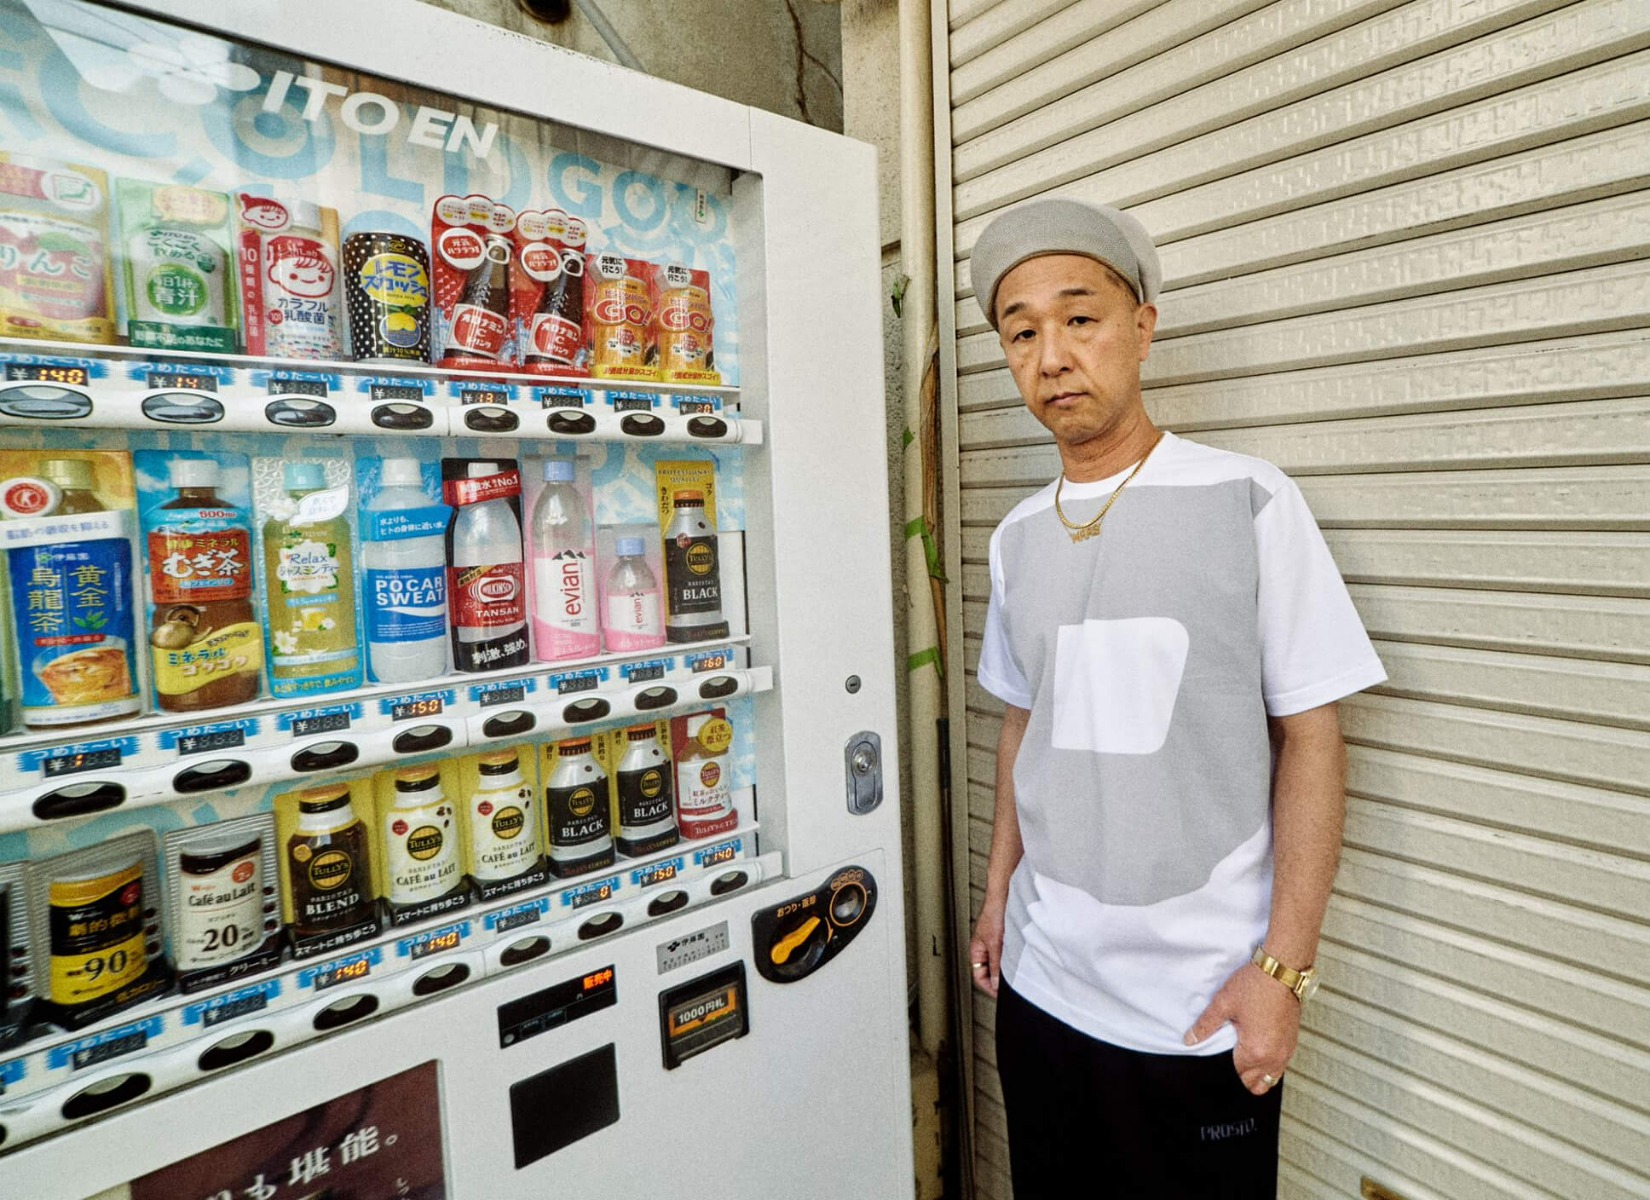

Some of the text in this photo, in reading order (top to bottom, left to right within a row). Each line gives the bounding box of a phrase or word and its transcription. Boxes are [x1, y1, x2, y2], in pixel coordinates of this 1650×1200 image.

[407, 105, 499, 158] EN
[375, 259, 421, 279] レモン
[601, 256, 622, 266] 元気に
[155, 290, 199, 307] 青汁
[278, 297, 329, 313] カラフル
[284, 309, 325, 325] 乳酸菌
[477, 327, 487, 338] C
[555, 336, 565, 346] C
[162, 548, 245, 579] むぎ茶
[290, 552, 328, 564] Relax
[69, 565, 109, 608] 黄金
[376, 588, 444, 606] SWEAT
[560, 562, 582, 616] evian
[682, 586, 719, 600] BLACK
[475, 606, 520, 618] TANSAN
[634, 598, 643, 624] evian
[168, 647, 227, 666] ミネラル
[633, 801, 669, 818] BLACK
[562, 819, 604, 837] BLACK
[481, 841, 535, 864] CAFÉ au LAIT
[396, 862, 457, 887] CAFÉ au LAIT
[483, 871, 545, 897] スマートに持ち歩こう
[188, 882, 256, 907] Café au Lait
[305, 892, 360, 916] BLEND
[396, 894, 465, 921] スマートに持ち歩こう
[202, 923, 239, 952] 20
[294, 922, 376, 957] スマートに持ち歩こう
[84, 950, 128, 982] 90
[583, 969, 614, 990] 販売中
[677, 996, 726, 1025] 1000円札
